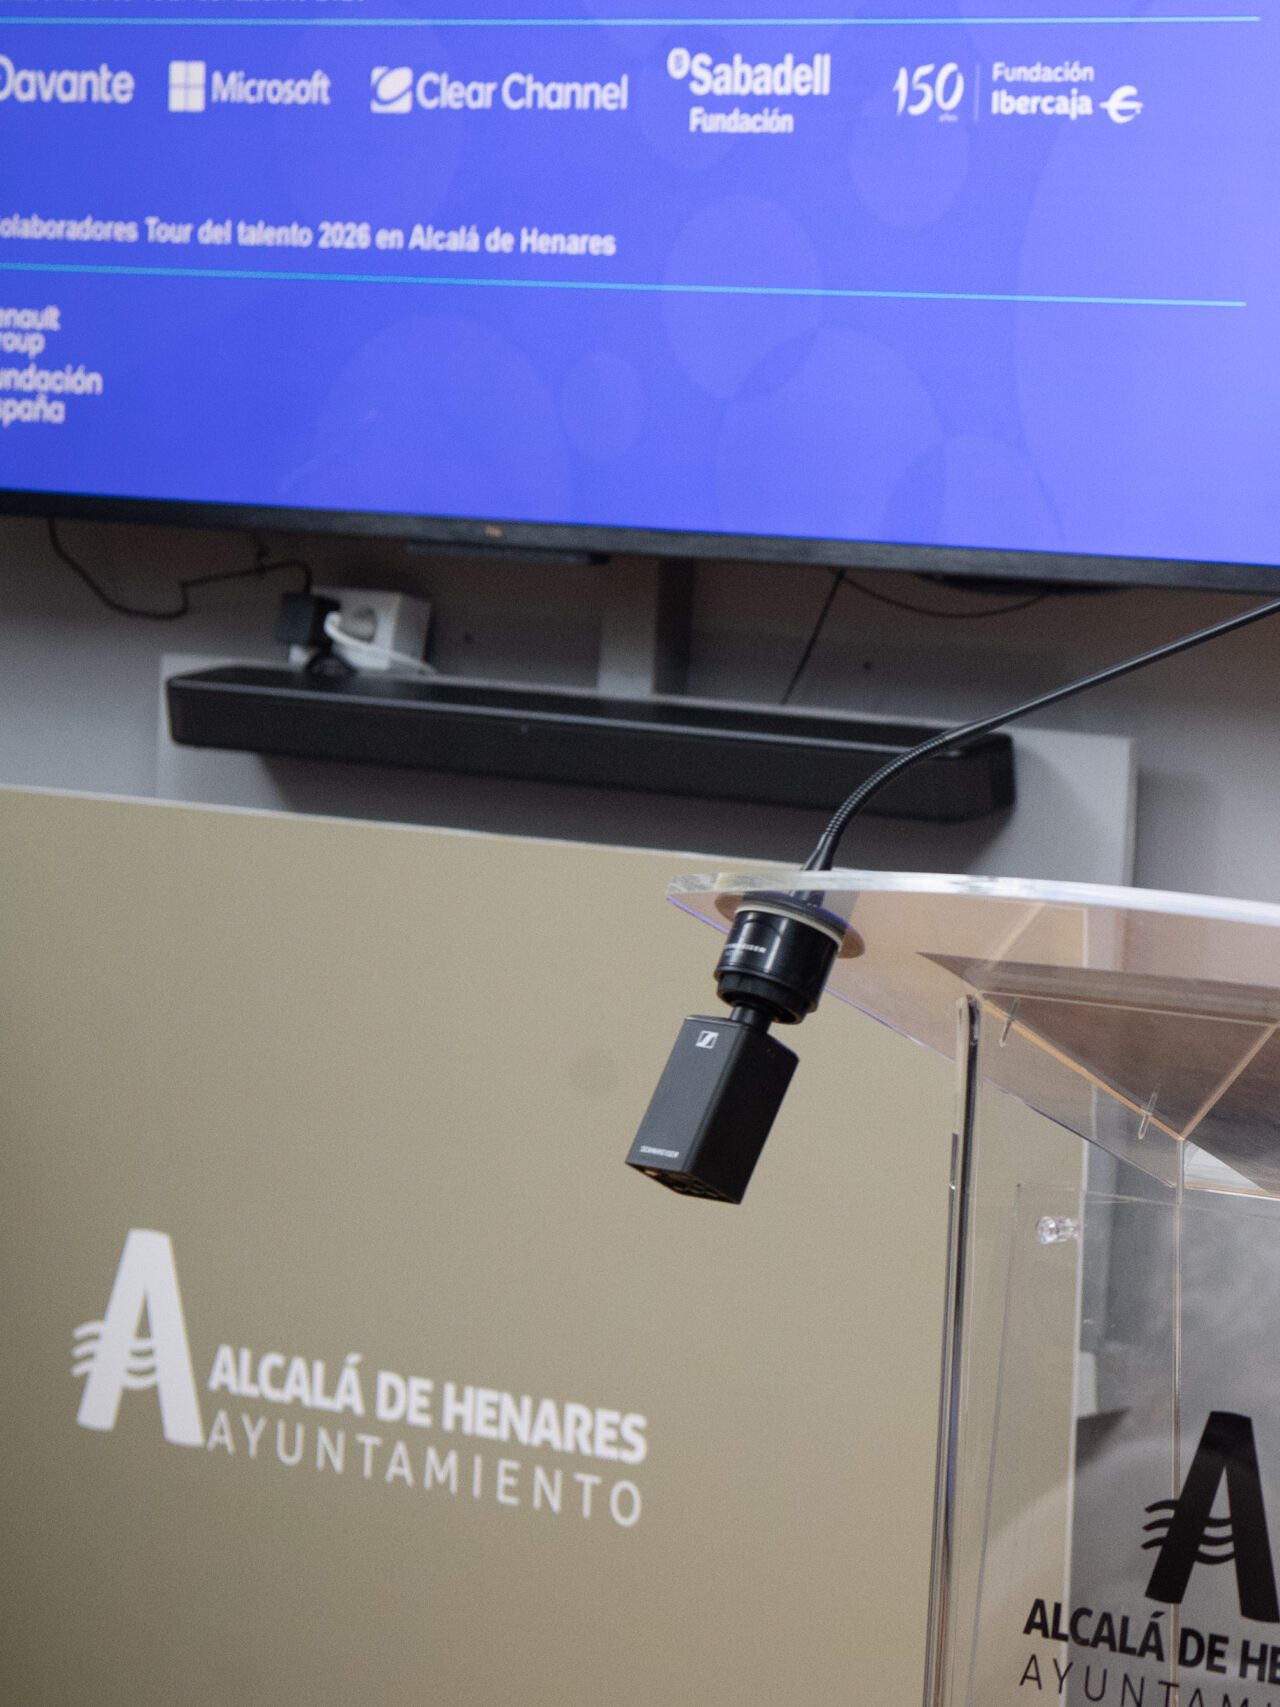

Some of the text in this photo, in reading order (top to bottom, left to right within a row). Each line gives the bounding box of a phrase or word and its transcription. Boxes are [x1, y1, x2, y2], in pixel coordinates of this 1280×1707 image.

[211, 69, 331, 105] Microsoft
[416, 71, 629, 110] Clear Channel
[688, 53, 831, 96] Sabadell
[893, 62, 965, 116] 150
[992, 61, 1095, 83] Fundación
[689, 106, 795, 134] Fundación
[991, 88, 1094, 121] Ibercaja
[145, 216, 193, 244] Tour
[197, 219, 232, 245] del
[237, 220, 314, 248] talento
[318, 221, 371, 249] 2026
[375, 228, 404, 250] en
[408, 223, 480, 252] Alcalá
[485, 226, 515, 253] de
[520, 227, 617, 256] Henares
[208, 1344, 647, 1464] ALCALÁ DE HENARES
[207, 1410, 642, 1527] AYUNTAMIENTO
[1022, 1598, 1165, 1662] ALCALÁ
[1178, 1627, 1229, 1674] DE
